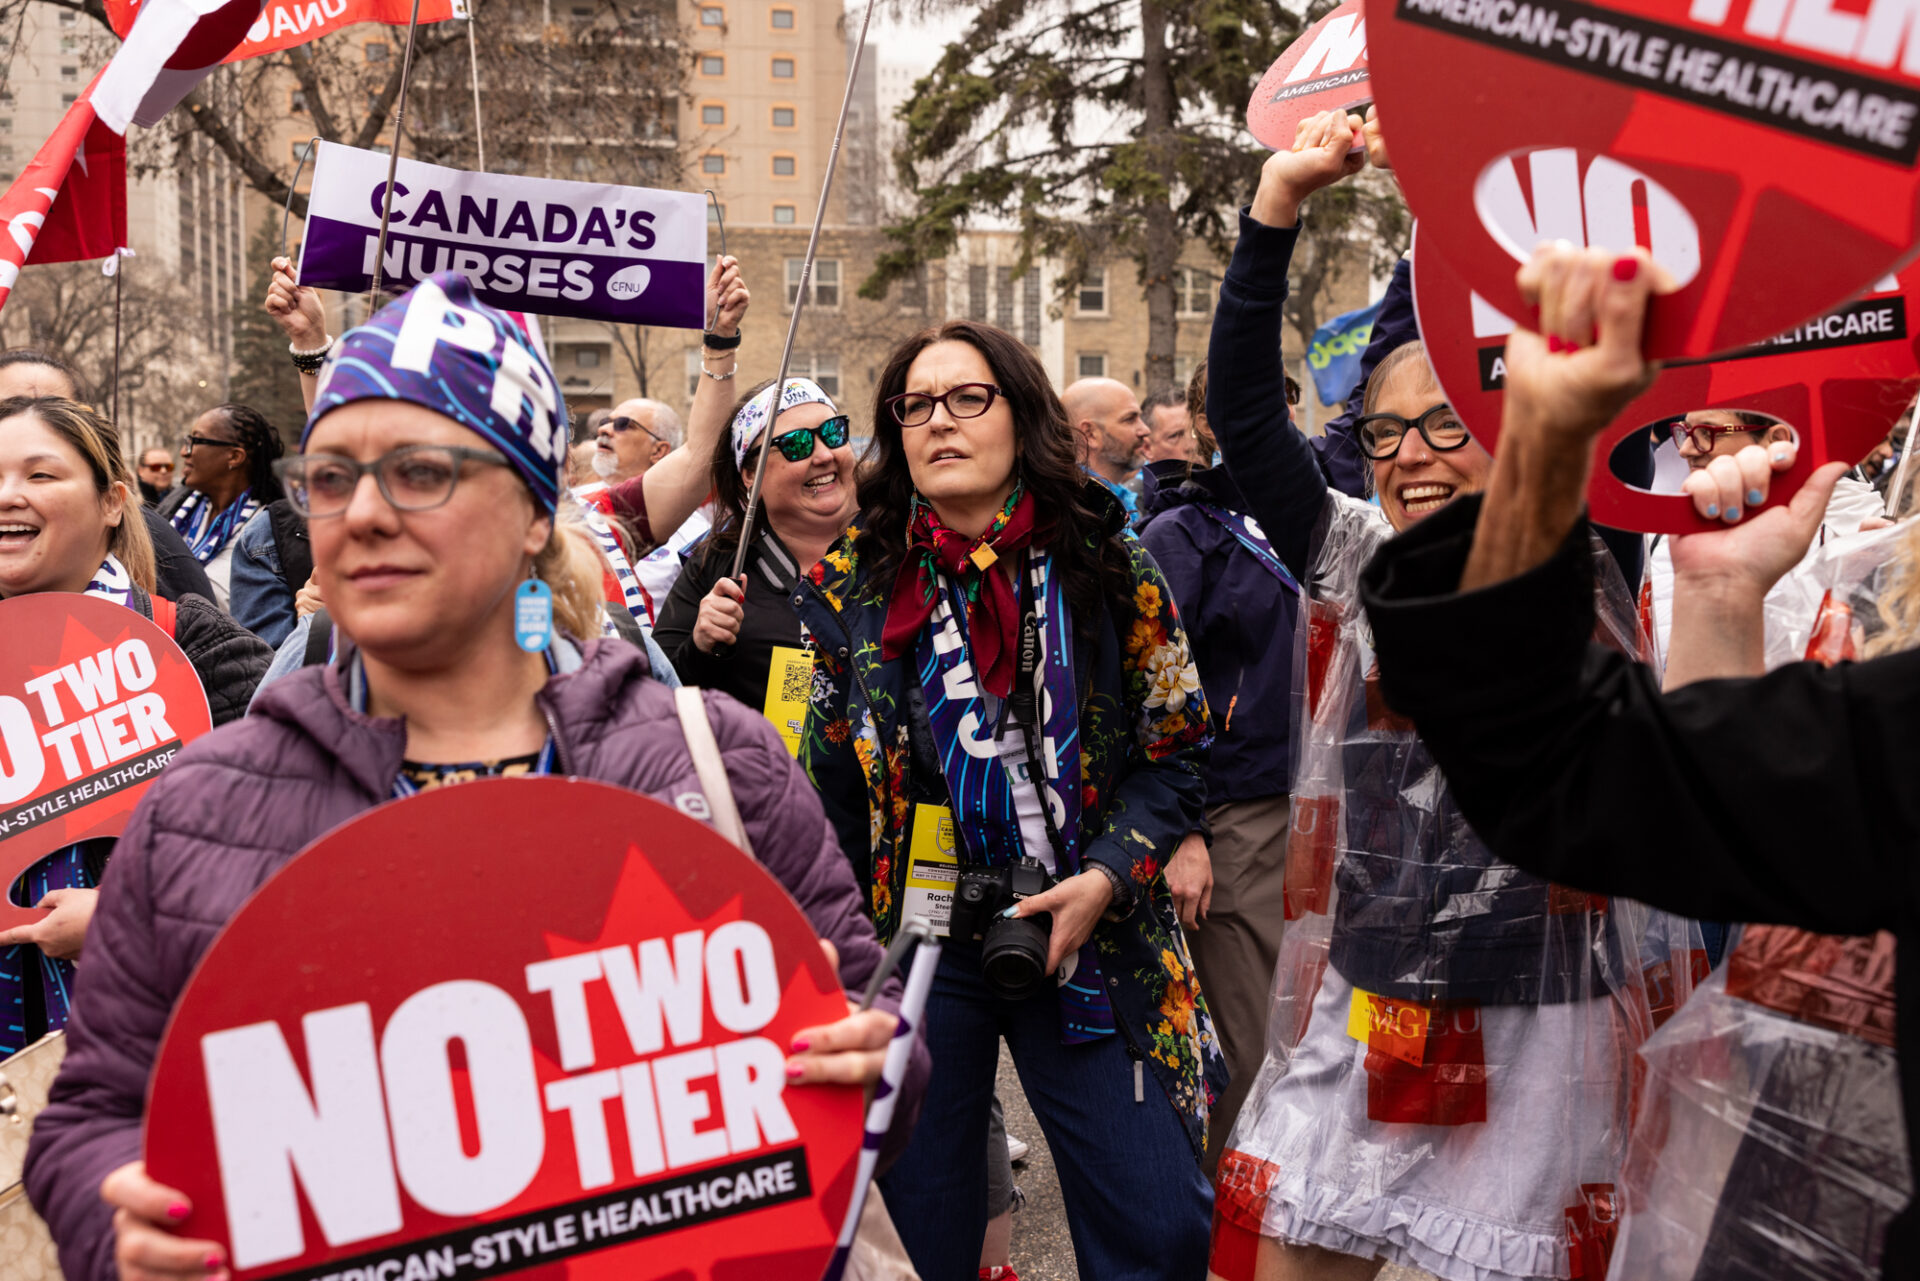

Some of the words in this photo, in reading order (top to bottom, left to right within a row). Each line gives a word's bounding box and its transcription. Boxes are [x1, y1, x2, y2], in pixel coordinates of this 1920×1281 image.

[1277, 71, 1369, 100] AMERICAN-
[1664, 43, 1919, 150] HEALTHCARE
[362, 234, 595, 301] NURSES
[611, 280, 641, 294] CFNU
[24, 638, 157, 728] TWO
[1021, 610, 1038, 672] Canon
[41, 692, 177, 781] TIER
[927, 892, 953, 903] Rach
[525, 920, 782, 1073] TWO
[201, 979, 546, 1271] NO
[545, 1036, 800, 1192] TIER
[583, 1161, 798, 1241] HEALTHCARE
